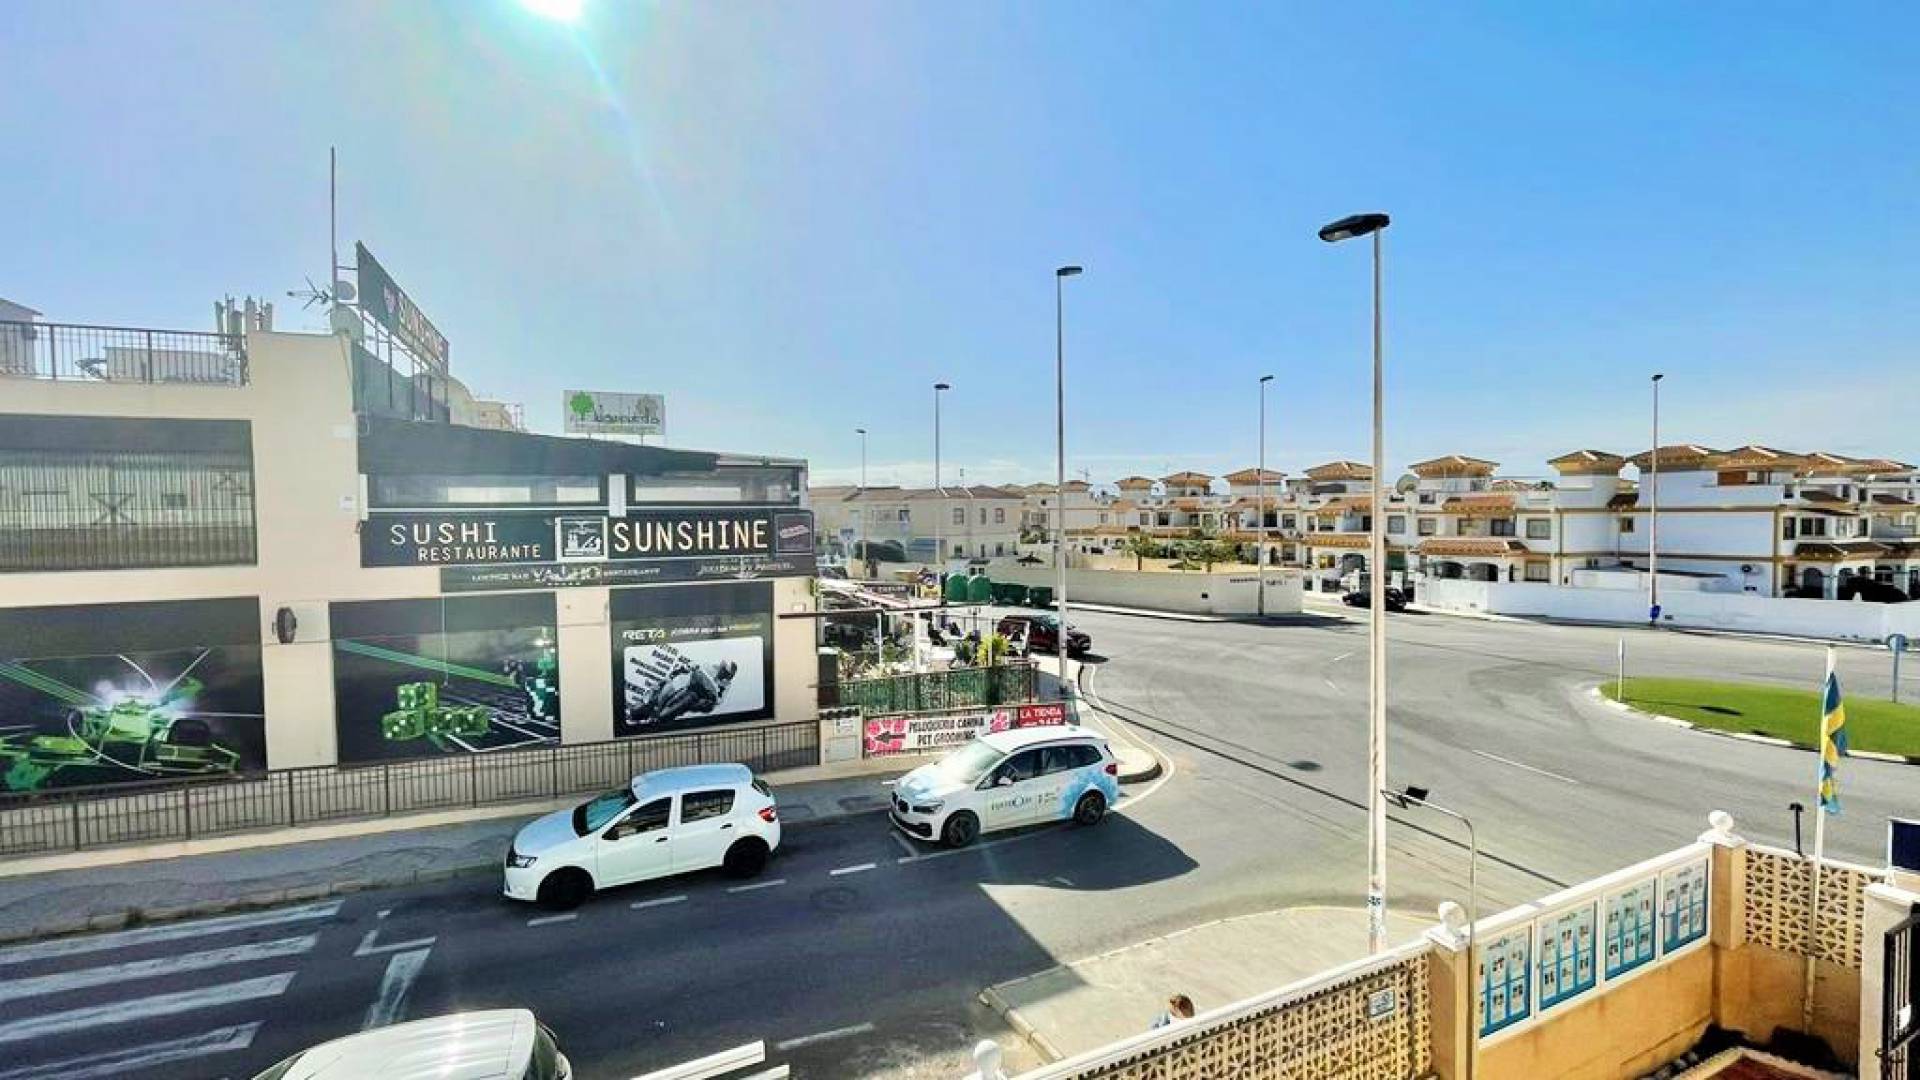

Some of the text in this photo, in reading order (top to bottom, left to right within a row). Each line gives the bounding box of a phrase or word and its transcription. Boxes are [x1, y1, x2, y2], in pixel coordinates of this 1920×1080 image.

[391, 522, 498, 545] SUSHI
[613, 520, 768, 552] SUNSHINE
[418, 544, 541, 562] RESTAURANTE
[917, 734, 932, 745] PET
